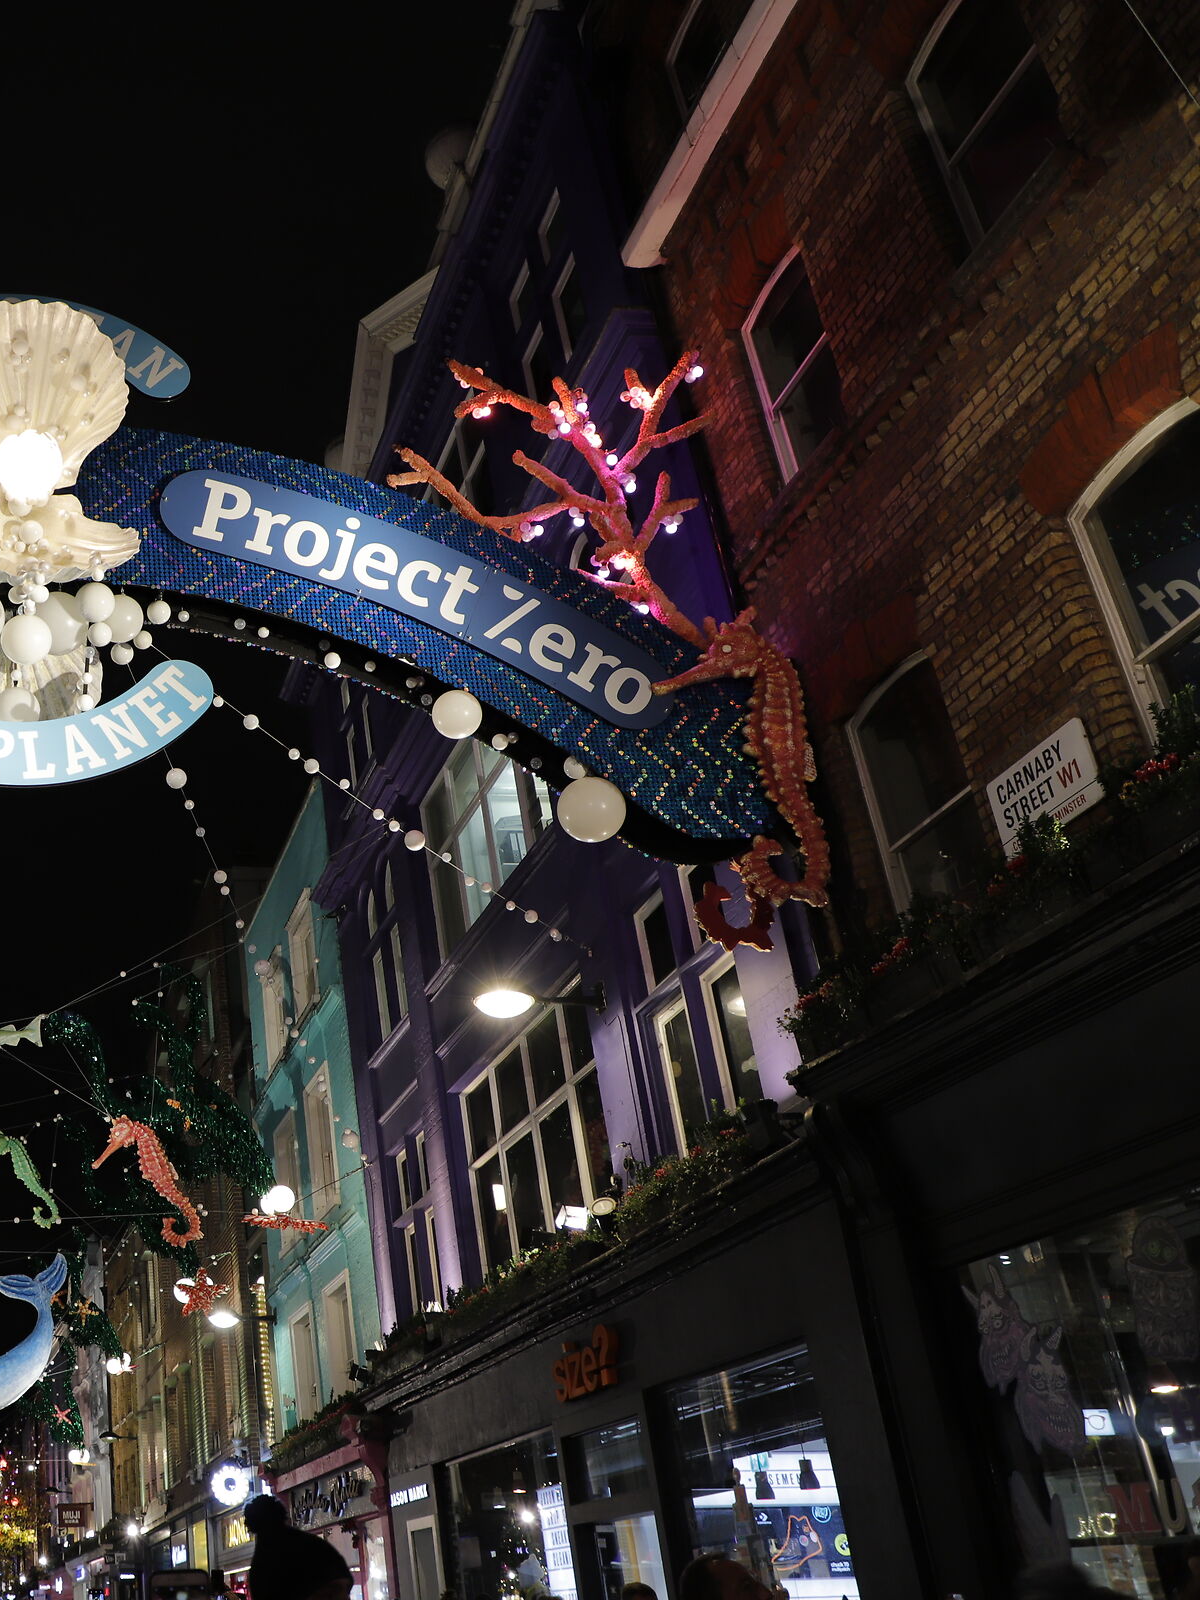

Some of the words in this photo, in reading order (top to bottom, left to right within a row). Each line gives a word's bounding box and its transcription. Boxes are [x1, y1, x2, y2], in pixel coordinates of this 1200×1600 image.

[192, 479, 480, 626] Project
[484, 586, 654, 715] Zero
[997, 740, 1062, 805] CARNABY
[1004, 776, 1055, 829] STREET
[1056, 758, 1082, 789] W1
[1049, 794, 1087, 821] TMINSTER
[552, 1324, 616, 1402] size?
[390, 1490, 409, 1508] JASON
[768, 1473, 802, 1486] SEMEN
[62, 1510, 81, 1520] MUJI
